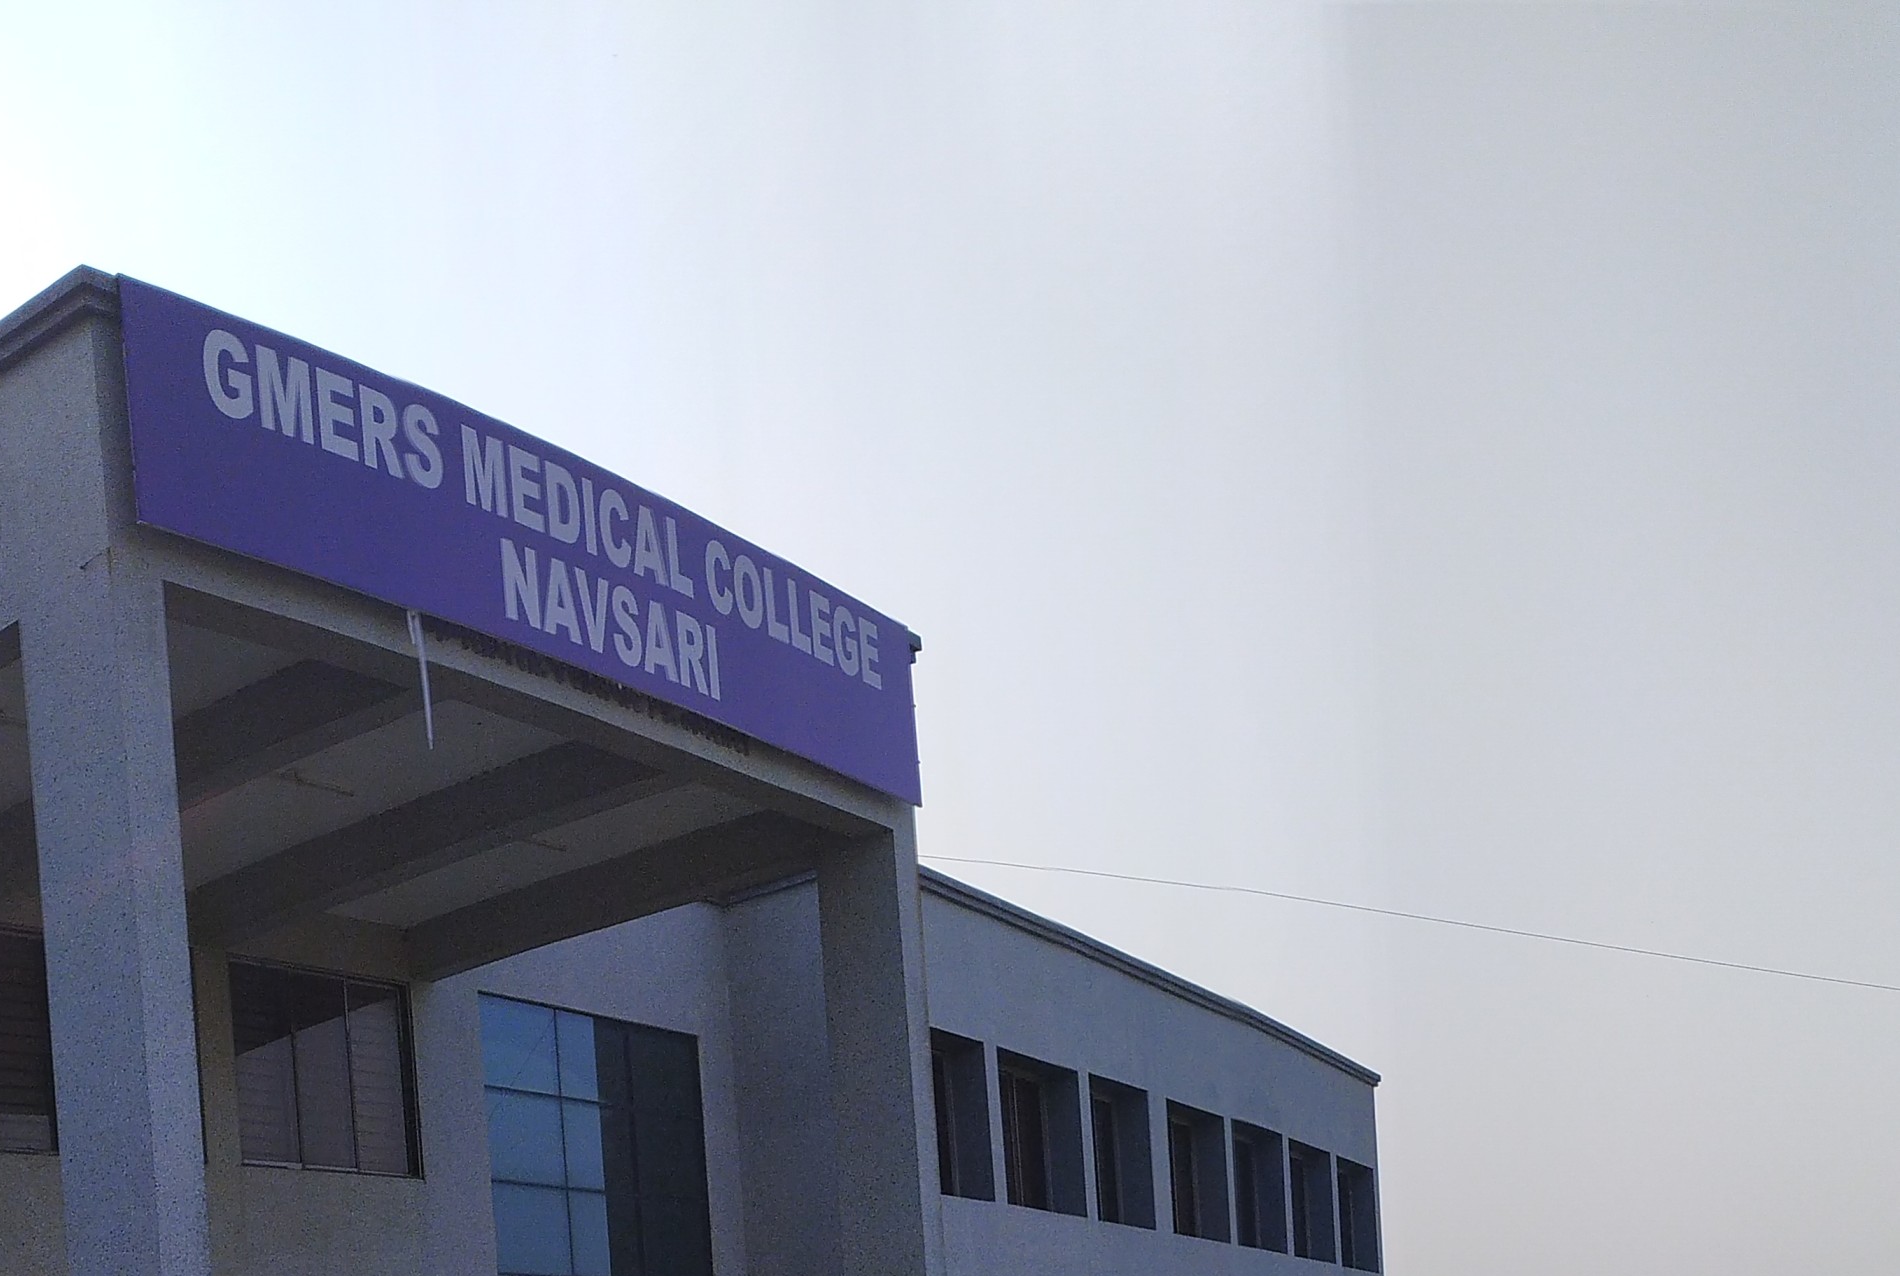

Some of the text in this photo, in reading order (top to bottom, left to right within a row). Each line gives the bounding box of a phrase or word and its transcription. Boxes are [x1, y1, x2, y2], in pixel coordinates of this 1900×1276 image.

[202, 328, 884, 691] GMERS MEDICAL COLLEGE
[499, 537, 723, 703] NAVSARI
